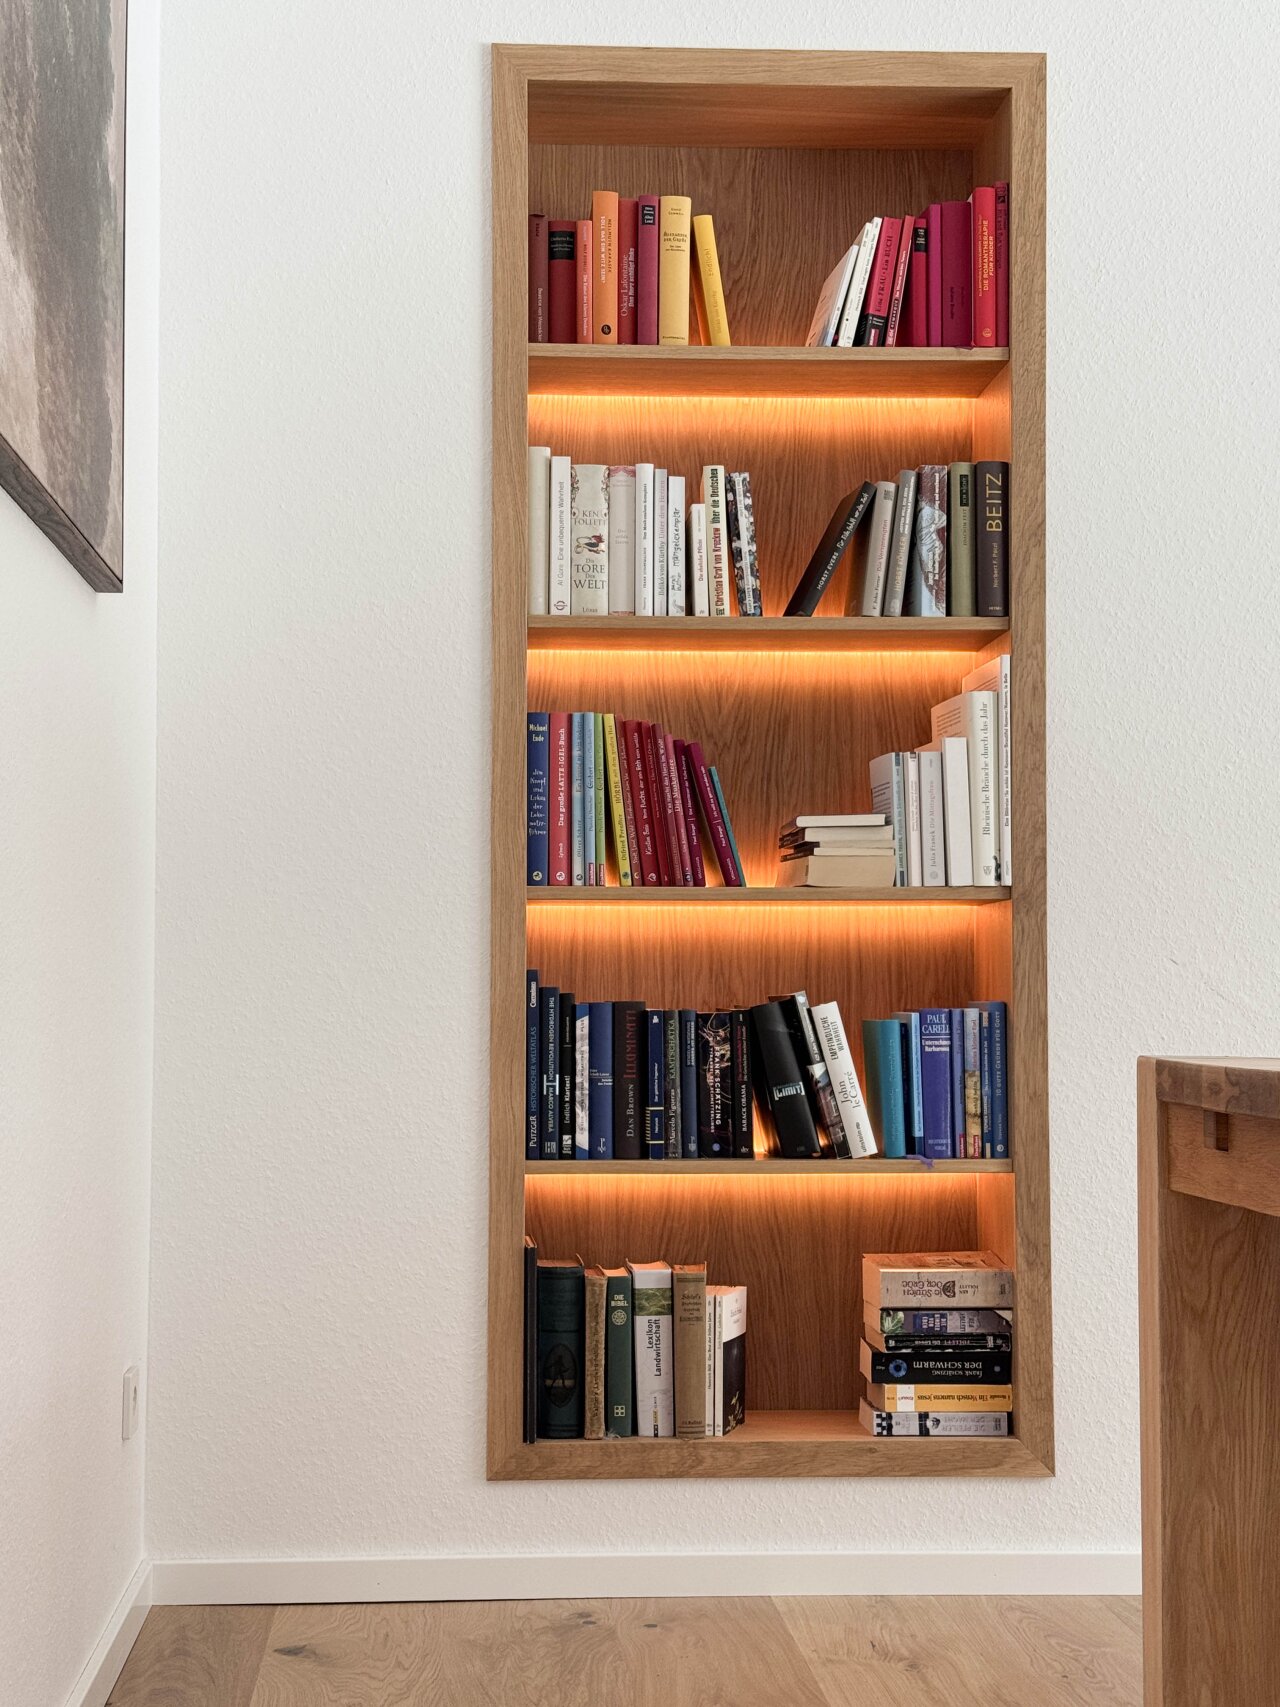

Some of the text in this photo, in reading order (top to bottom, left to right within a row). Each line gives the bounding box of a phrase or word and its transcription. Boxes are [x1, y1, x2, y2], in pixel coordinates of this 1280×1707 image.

[876, 275, 886, 296] FRAU
[884, 235, 894, 258] BUCH
[621, 254, 629, 316] Oskar Lafontaine
[710, 468, 720, 498] Deutschen
[710, 500, 719, 508] die
[986, 473, 1002, 532] BEITZ
[710, 510, 720, 524] Über
[574, 564, 606, 574] TORE
[714, 566, 722, 579] Graf
[816, 570, 830, 590] HORST
[827, 552, 840, 570] EVERS
[894, 536, 906, 591] HORST KÖHLER
[573, 580, 607, 590] WELT
[714, 581, 724, 607] Christian
[668, 758, 678, 798] Muskeltiere
[980, 702, 990, 836] Rheinische Bräuche durch das Jahr
[558, 792, 566, 812] große
[558, 814, 566, 826] Das
[922, 1025, 950, 1034] CARELL
[927, 1014, 946, 1024] PAUL
[820, 1016, 838, 1060] EMPFINDLICHE
[830, 1021, 844, 1052] WAHRHEIT
[841, 1080, 852, 1104] John
[653, 1319, 661, 1378] Landwirtschaft
